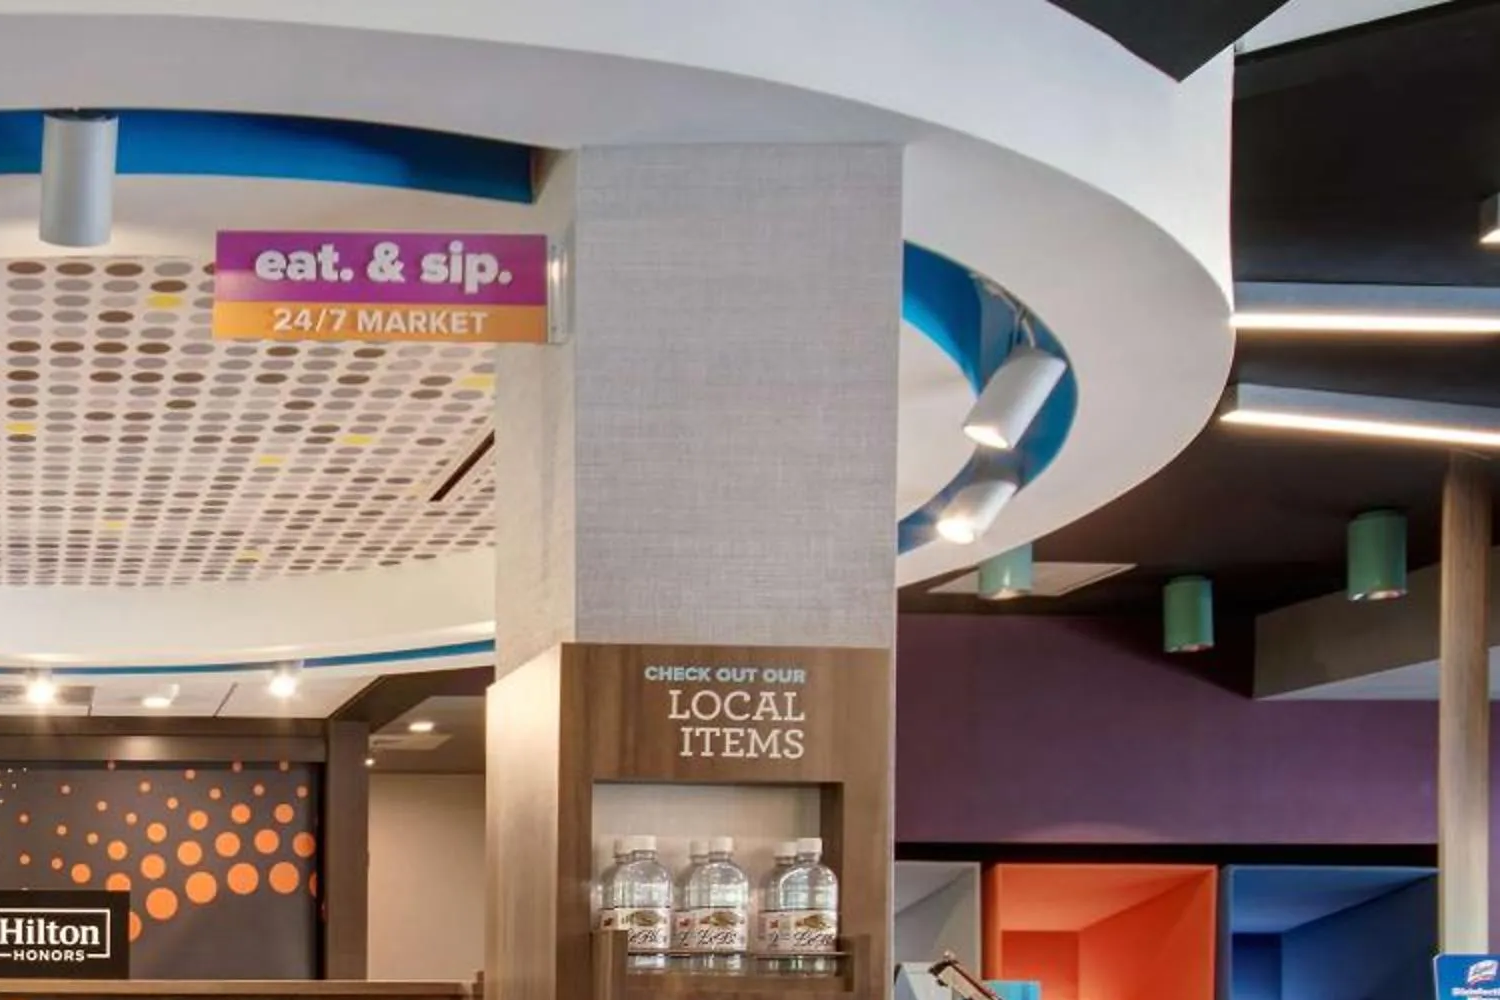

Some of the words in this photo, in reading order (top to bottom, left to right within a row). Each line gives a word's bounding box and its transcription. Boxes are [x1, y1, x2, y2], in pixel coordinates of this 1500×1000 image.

[255, 243, 354, 283] eat.
[366, 241, 406, 284] &
[420, 240, 513, 294] sip.
[273, 308, 347, 333] 24/7
[357, 309, 489, 335] MARKET
[644, 665, 711, 682] CHECK
[716, 667, 757, 683] OUT
[763, 668, 806, 684] OUR
[668, 689, 805, 721] LOCAL
[679, 727, 805, 759] ITEMS
[13, 949, 85, 962] HONORS
